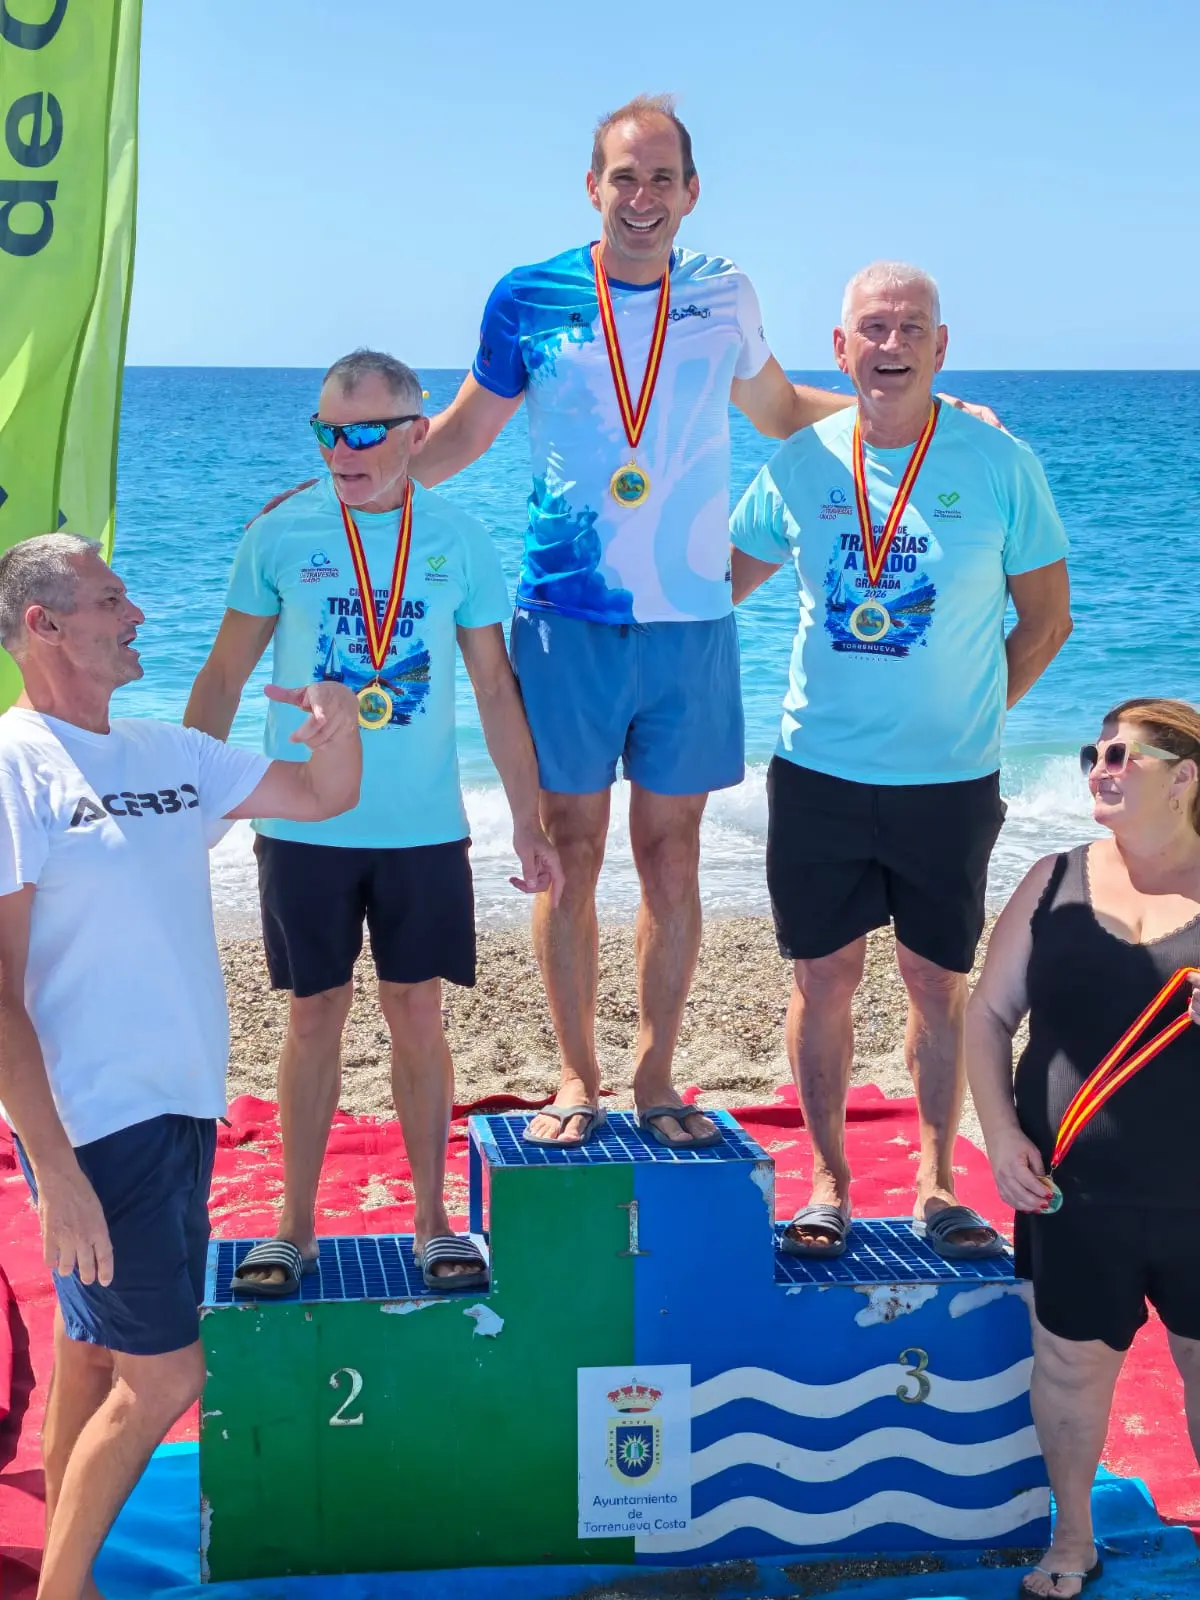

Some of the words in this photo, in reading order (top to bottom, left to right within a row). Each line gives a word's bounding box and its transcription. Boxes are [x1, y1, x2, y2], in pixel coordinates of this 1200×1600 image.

[0, 91, 63, 257] de
[840, 534, 928, 553] TRVSÍAS
[844, 552, 857, 570] A
[863, 554, 917, 573] DO
[349, 588, 389, 598] CIITO
[864, 590, 887, 599] 2026
[327, 597, 425, 619] TRAEAS
[336, 616, 350, 635] A
[356, 617, 414, 638] NO
[348, 643, 398, 655] GRAA
[842, 643, 896, 653] TORRENUEVA
[896, 1347, 930, 1404] 3
[329, 1367, 364, 1426] 2
[592, 1494, 678, 1508] Ayuntamiento
[627, 1509, 643, 1519] de
[584, 1521, 651, 1533] Torrenueva
[654, 1518, 686, 1530] Costa
